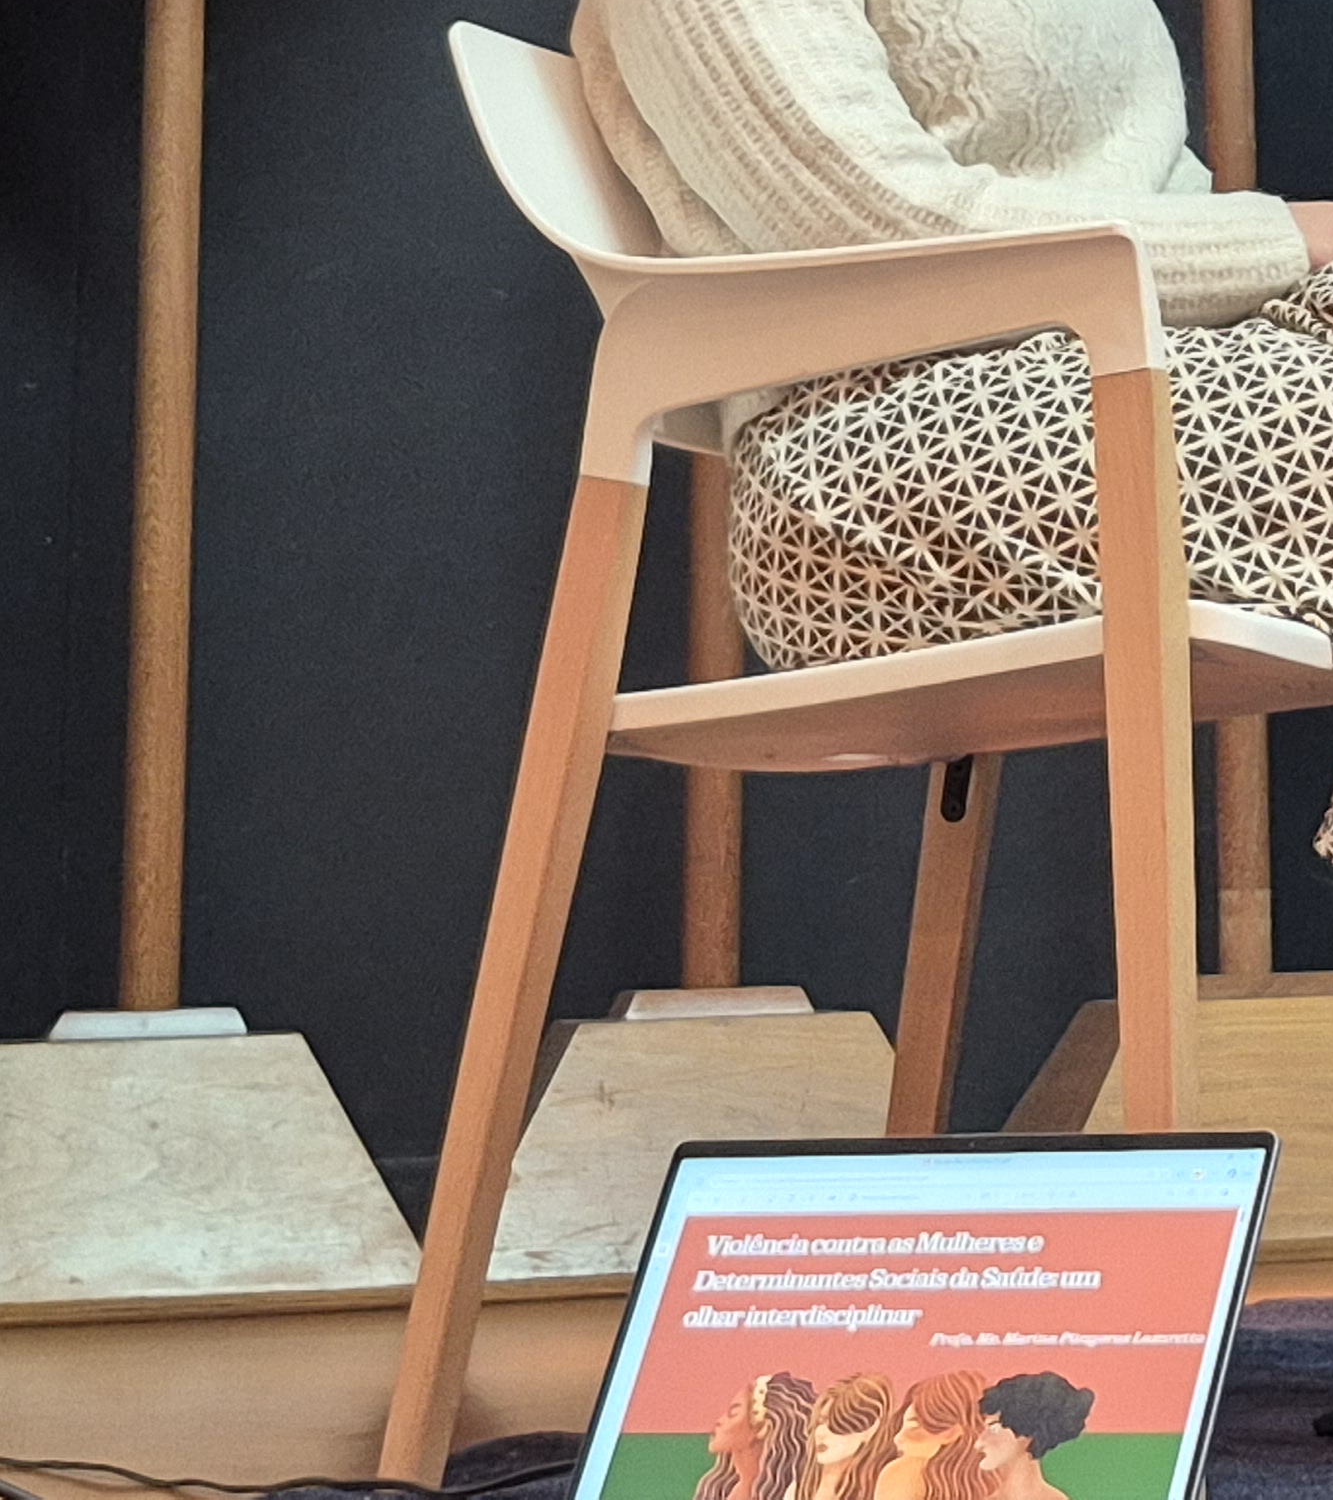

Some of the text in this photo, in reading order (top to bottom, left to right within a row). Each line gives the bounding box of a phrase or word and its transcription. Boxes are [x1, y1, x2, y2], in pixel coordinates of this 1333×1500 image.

[707, 1232, 1044, 1257] Violência contra as Mulheres e
[693, 1268, 865, 1292] Determinantes
[868, 1268, 947, 1290] Sociais
[949, 1268, 978, 1289] da
[1060, 1270, 1101, 1289] um
[683, 1303, 923, 1332] olhar interdisciplinar
